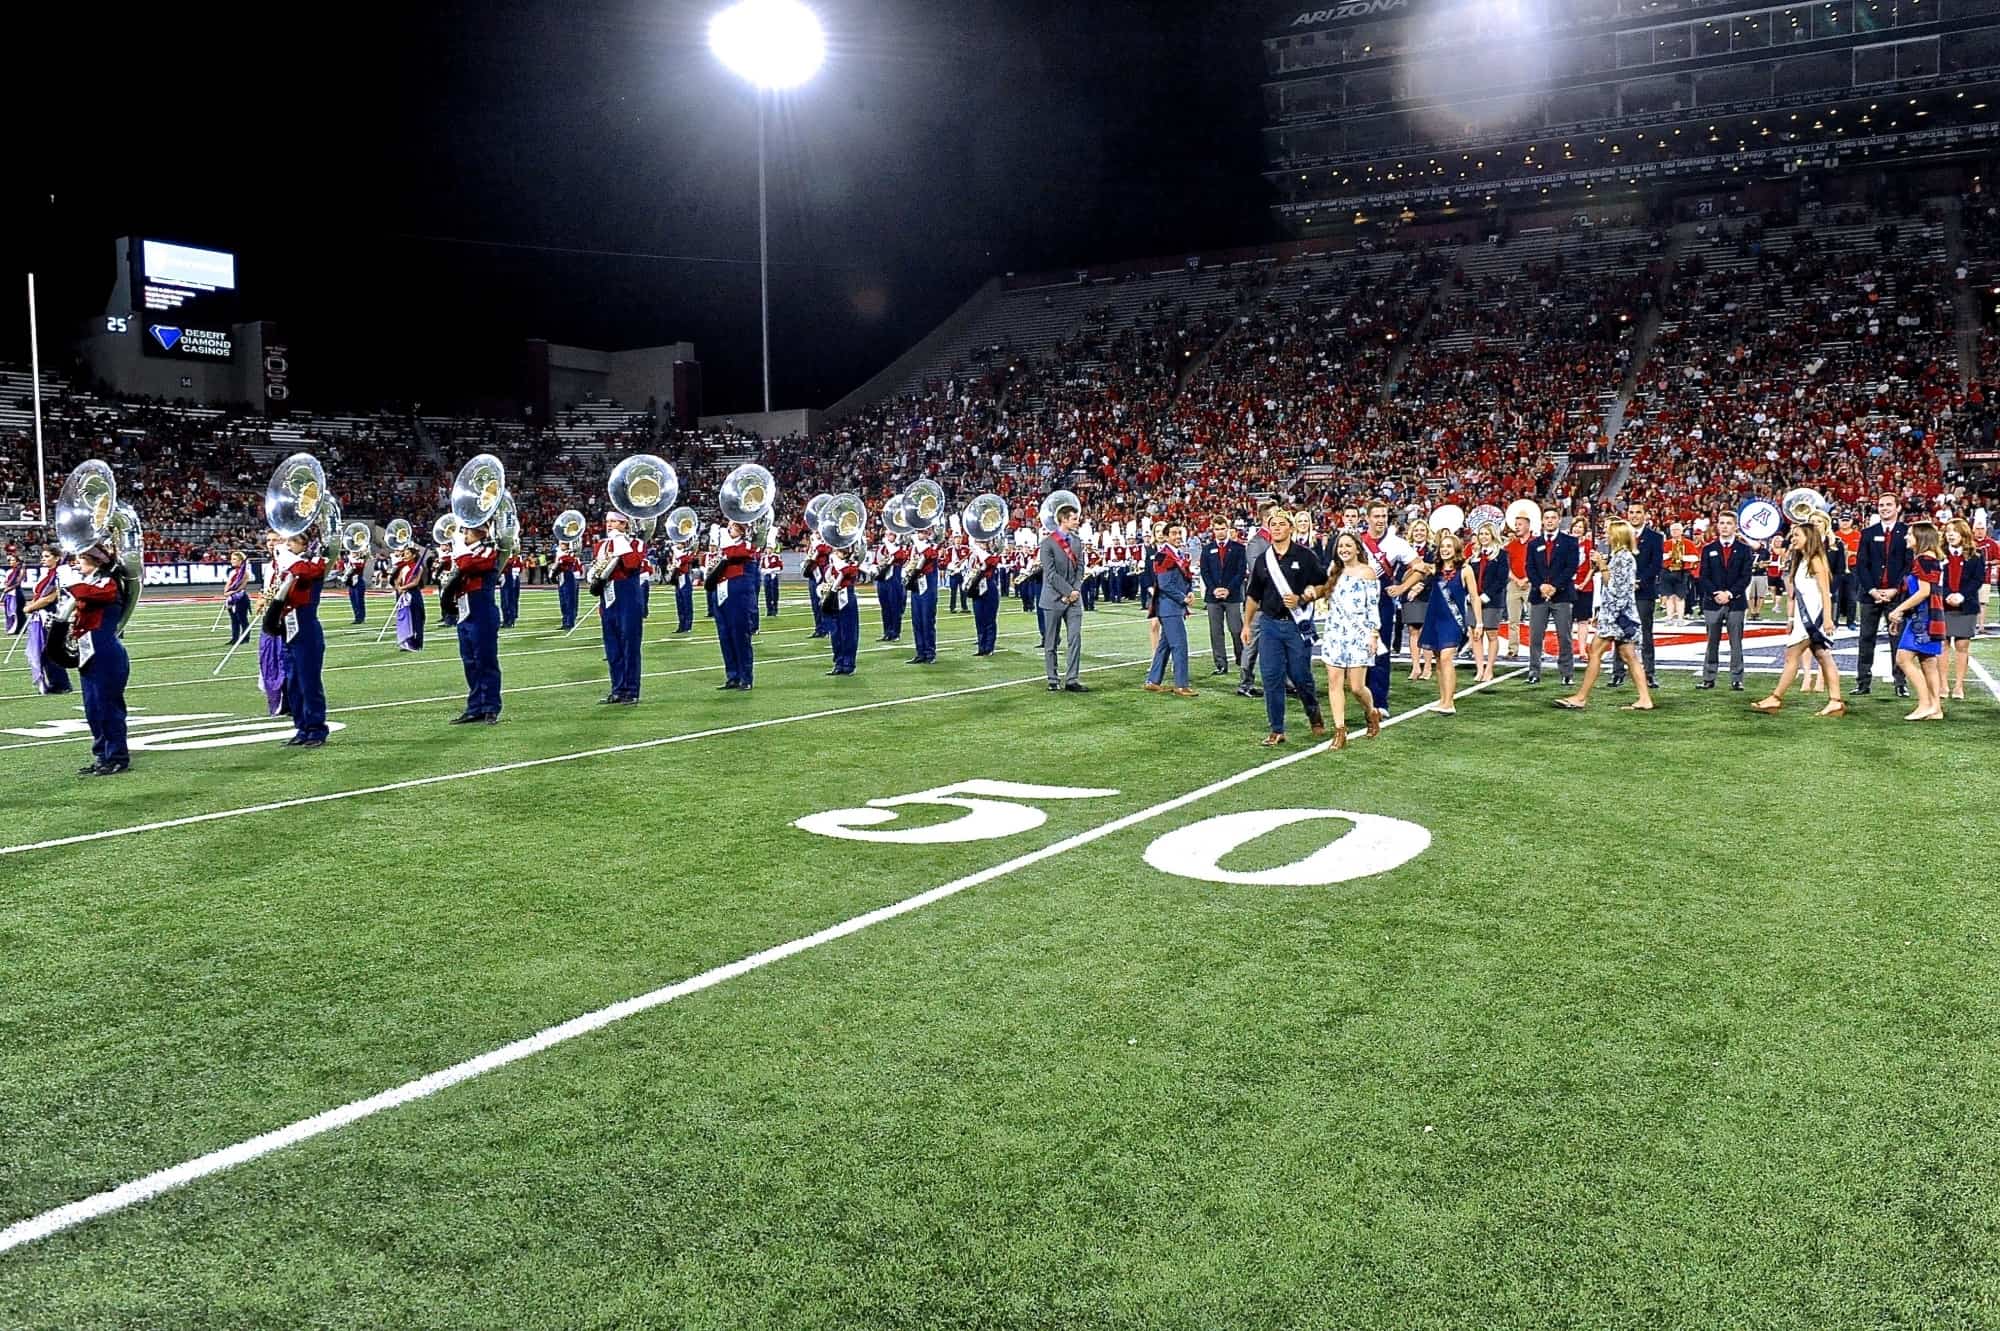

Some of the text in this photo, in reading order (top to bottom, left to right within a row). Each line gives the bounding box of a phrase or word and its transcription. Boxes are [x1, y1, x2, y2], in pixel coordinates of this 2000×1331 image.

[107, 316, 127, 332] 25
[185, 328, 226, 340] DESERT
[180, 336, 231, 348] DIAMOND
[182, 345, 230, 356] CASINOS
[787, 779, 1432, 885] 50
